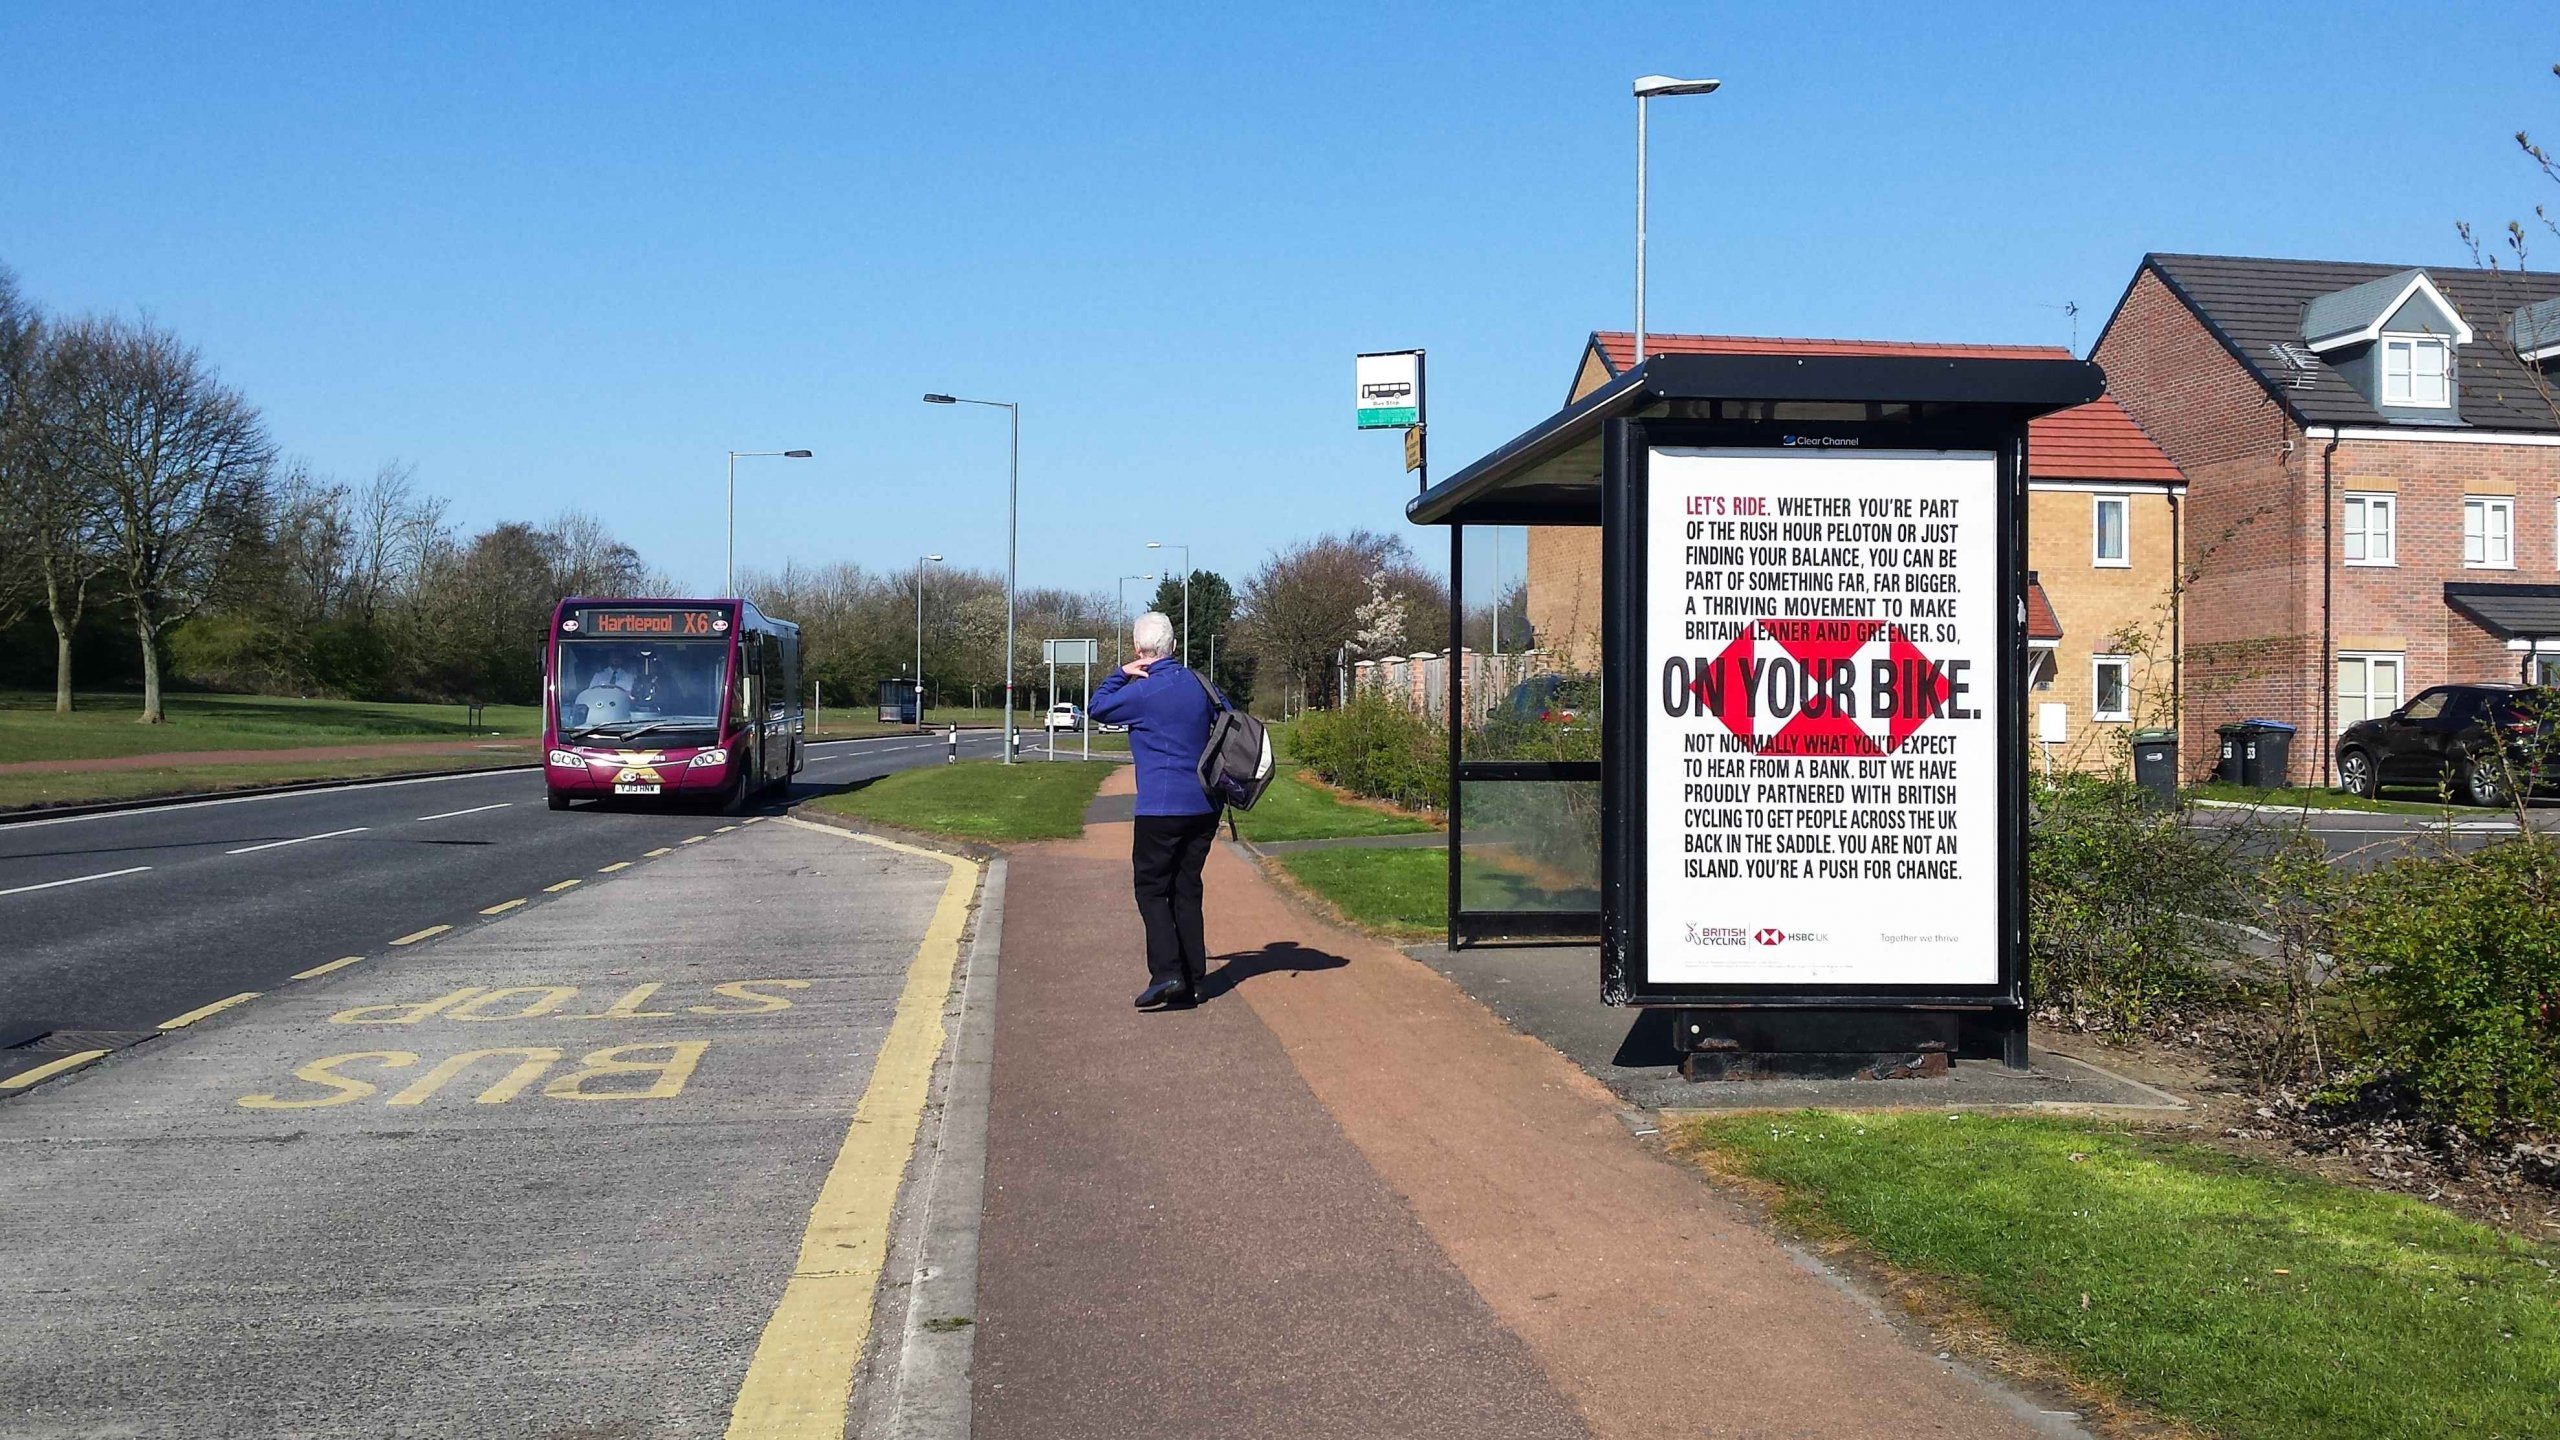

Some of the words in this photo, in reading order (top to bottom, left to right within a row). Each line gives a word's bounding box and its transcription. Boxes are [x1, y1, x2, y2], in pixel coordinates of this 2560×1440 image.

[1797, 436, 1820, 445] Clear
[1822, 436, 1859, 446] Channel
[1686, 496, 1726, 516] LET'S
[1733, 497, 1771, 517] RIDE.
[1777, 497, 1851, 517] WHETHER
[1858, 499, 1912, 518] YOU'RE
[1919, 499, 1959, 518] PART
[1686, 520, 1705, 541] OF
[1708, 521, 1735, 541] THE
[1740, 521, 1778, 542] RUSH
[1783, 521, 1822, 542] HOUR
[1827, 522, 1892, 543] PELOTON
[1897, 523, 1917, 543] OR
[1920, 523, 1959, 544] JUST
[1685, 545, 1744, 567] FINDING
[1749, 546, 1787, 567] YOUR
[1792, 547, 1864, 571] BALANCE,
[1868, 547, 1898, 568] YOU
[1903, 548, 1934, 568] CAN
[1939, 548, 1957, 569] BE
[1685, 570, 1723, 591] PART
[1727, 571, 1745, 591] OF
[1748, 571, 1833, 592] SOMETHING
[1838, 572, 1870, 596] FAR,
[1874, 572, 1900, 593] FAR
[1905, 572, 1961, 593] BIGGER.
[1684, 596, 1697, 616] A
[1703, 597, 1777, 617] THRIVING
[1784, 597, 1876, 617] MOVEMENT
[1882, 598, 1903, 617] TO
[1910, 598, 1957, 618] MAKE
[598, 615, 672, 632] Hartlepool
[683, 613, 709, 633] X6
[1685, 620, 1744, 641] BRITAIN
[1749, 621, 1810, 642] LEANER
[1816, 621, 1851, 642] AND
[1857, 622, 1933, 643] GREENER.
[1936, 622, 1961, 646] SO,
[1662, 655, 1725, 718] ON
[1738, 656, 1857, 719] YOUR
[1870, 657, 1982, 720] BIKE.
[1684, 733, 1715, 753] NOT
[1719, 734, 1798, 754] NORMALLY
[1804, 734, 1849, 754] WHAT
[1853, 734, 1897, 754] YOU'D
[1901, 735, 1957, 755] EXPECT
[1683, 759, 1702, 778] TO
[1707, 759, 1745, 778] HEAR
[1749, 759, 1790, 779] FROM
[1794, 760, 1805, 779] A
[1809, 759, 1855, 780] BANK.
[1858, 759, 1887, 779] BUT
[1890, 759, 1915, 780] WE
[1919, 760, 1957, 780] HAVE
[1684, 784, 1751, 803] PROUDLY
[1757, 784, 1845, 804] PARTNERED
[1851, 784, 1891, 804] WITH
[1898, 785, 1956, 805] BRITISH
[1684, 809, 1743, 829] CYCLING
[1745, 809, 1764, 829] TO
[1767, 810, 1794, 829] GET
[1796, 809, 1848, 830] PEOPLE
[1850, 809, 1906, 830] ACROSS
[1908, 810, 1936, 830] THE
[1938, 811, 1958, 830] UK
[1684, 834, 1723, 853] BACK
[1726, 834, 1741, 853] IN
[1745, 835, 1773, 854] THE
[1776, 834, 1835, 854] SADDLE.
[1837, 834, 1867, 854] YOU
[1870, 834, 1899, 854] ARE
[1903, 834, 1933, 855] NOT
[1935, 836, 1957, 855] AN
[1684, 859, 1743, 878] ISLAND.
[1745, 859, 1799, 879] YOU'RE
[1803, 859, 1814, 879] A
[1819, 859, 1859, 879] PUSH
[1864, 859, 1892, 880] FOR
[1896, 860, 1962, 880] CHANGE.
[1702, 927, 1746, 937] BRITISH
[1702, 937, 1746, 946] CYCLING
[1788, 932, 1815, 942] HSBC
[1815, 932, 1829, 942] UK
[1880, 932, 1918, 944] Together
[1919, 934, 1933, 943] we
[1934, 932, 1960, 943] thrive
[328, 978, 811, 1024] STOP
[237, 1039, 711, 1109] BUS
